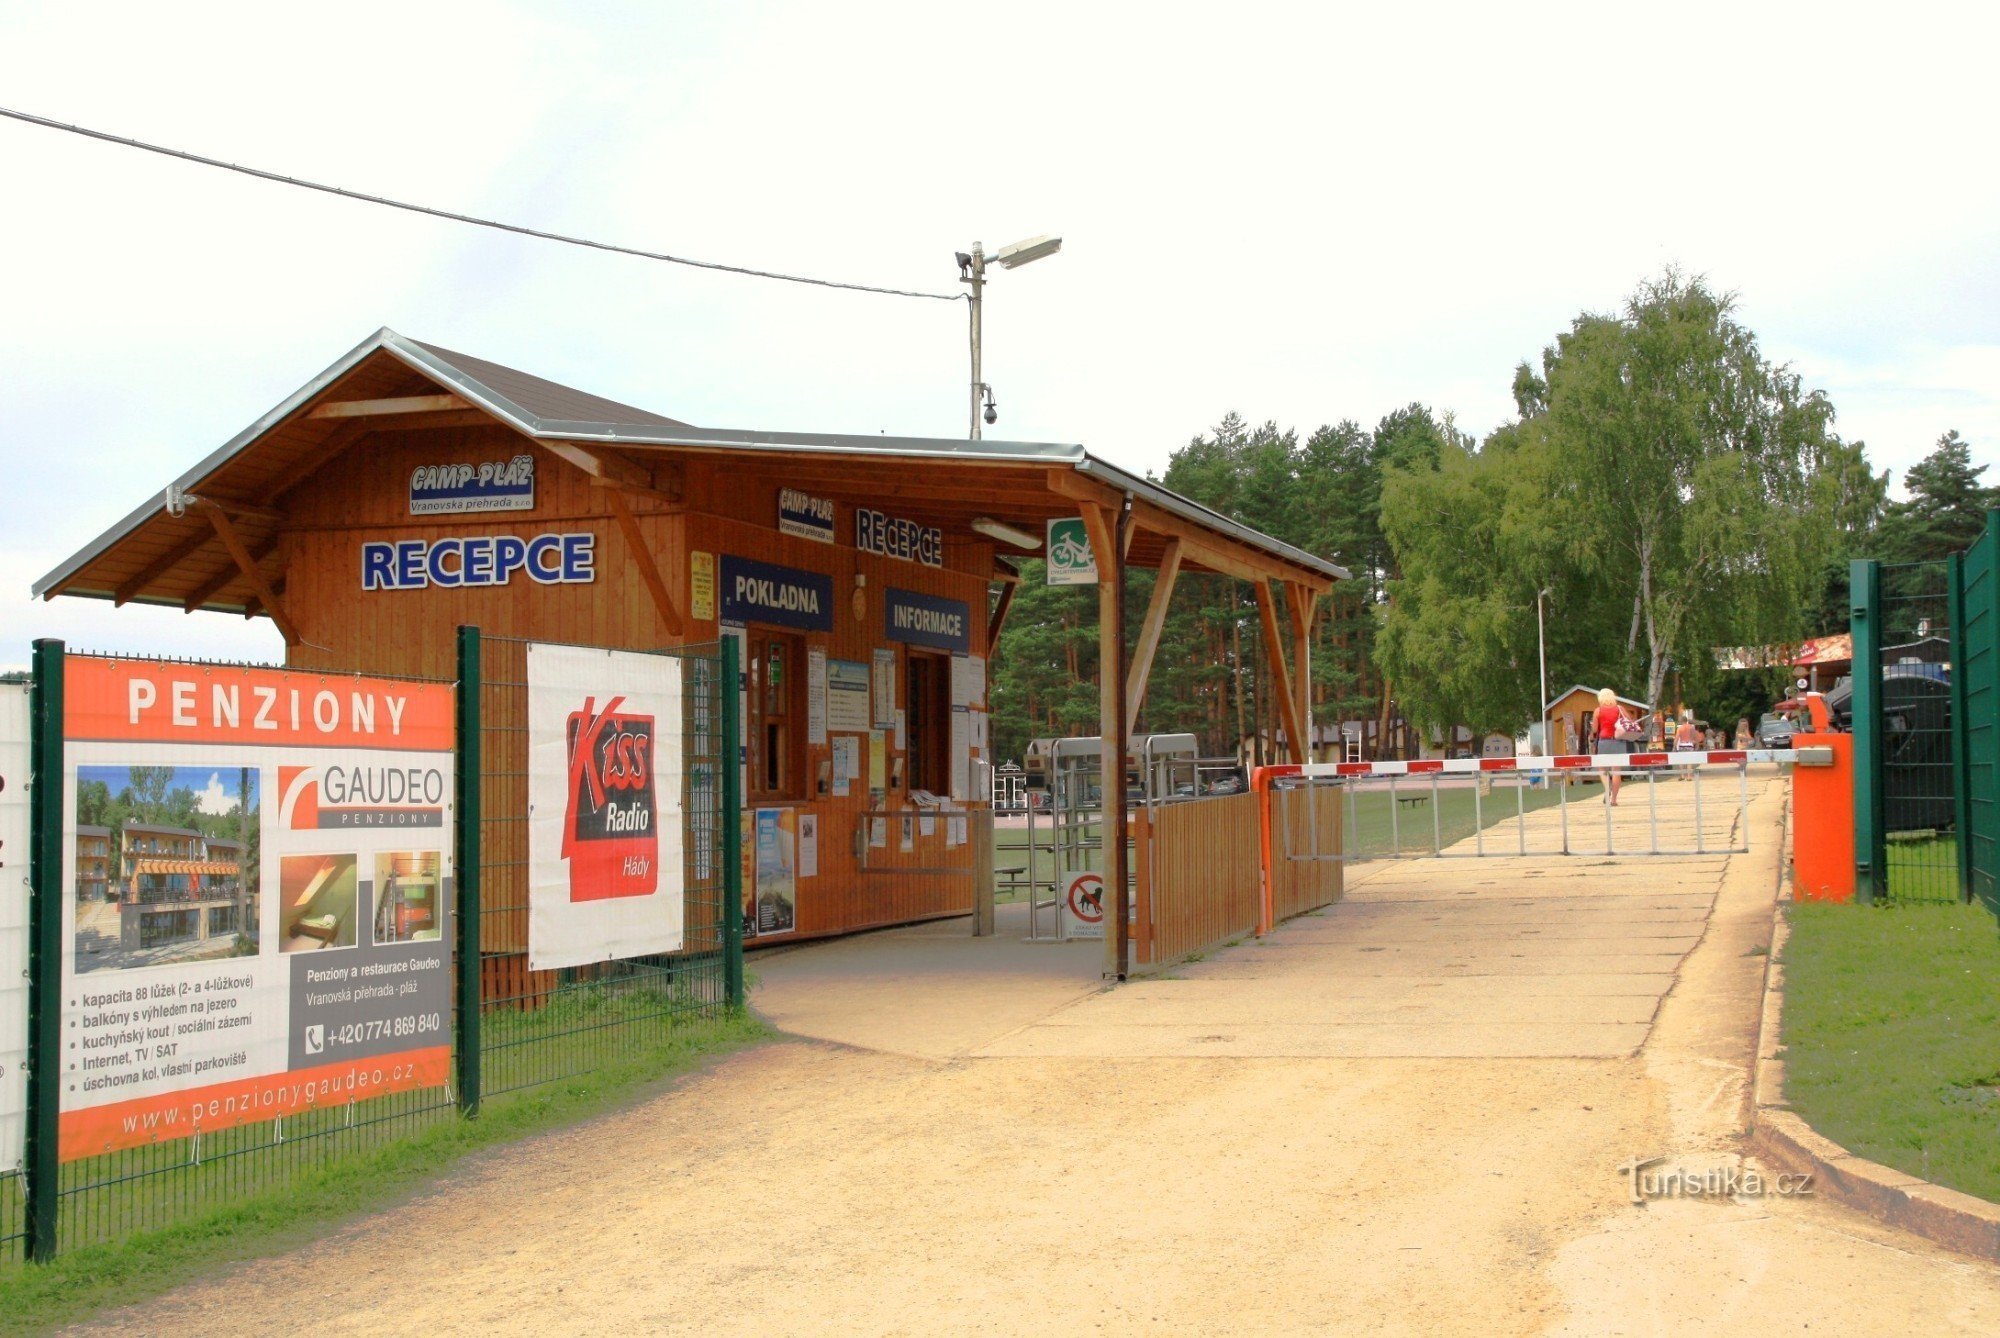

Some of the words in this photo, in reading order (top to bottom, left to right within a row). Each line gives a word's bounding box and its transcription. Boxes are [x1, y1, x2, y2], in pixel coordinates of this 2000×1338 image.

[411, 464, 475, 491] CAMP
[478, 456, 534, 487] PLÁŽ
[411, 500, 463, 512] Vranovská
[465, 498, 512, 509] přehrada
[781, 488, 808, 514] CAMP
[857, 509, 942, 568] RECEPCE
[363, 534, 594, 589] RECEPCE
[735, 575, 820, 615] POKLADNA
[894, 604, 962, 637] INFORMACE
[128, 678, 407, 736] PENZIONY
[570, 696, 648, 815] Kiss
[324, 765, 443, 804] GAUDEO
[341, 813, 428, 824] PENZIONY
[606, 802, 649, 832] Radio
[623, 856, 650, 880] Hády
[307, 967, 349, 983] Penziony
[351, 967, 357, 977] a
[361, 961, 408, 976] restaurace
[409, 957, 441, 971] Gaudeo
[82, 990, 133, 1009] kapacita
[135, 987, 148, 1001] 88
[151, 983, 176, 998] lůžek
[178, 982, 192, 998] (2-
[194, 983, 201, 993] a
[204, 974, 253, 992] 4-lůžkové)
[306, 988, 351, 1006] Vranovská
[354, 984, 394, 1003] přehrada
[400, 980, 418, 996] pláž
[82, 1010, 130, 1028] balkóny
[132, 1009, 139, 1021] s
[141, 1002, 187, 1023] výhledem
[190, 1000, 204, 1013] na
[205, 997, 237, 1015] jezero
[82, 1028, 145, 1049] kuchyňský
[146, 1025, 170, 1040] kout
[177, 1017, 216, 1035] sociální
[217, 1011, 252, 1030] zázemí
[327, 1023, 364, 1047] +420
[366, 1019, 391, 1041] 774
[394, 1015, 416, 1037] 869
[418, 1012, 440, 1033] 840
[82, 1052, 133, 1071] Internet,
[135, 1048, 149, 1063] TV
[156, 1043, 179, 1058] SAT
[83, 1071, 139, 1092] úschovna
[142, 1067, 160, 1082] kol,
[161, 1059, 192, 1077] vlastní
[194, 1050, 247, 1075] parkoviště
[122, 1062, 415, 1134] www.penzionygaudeo.cz
